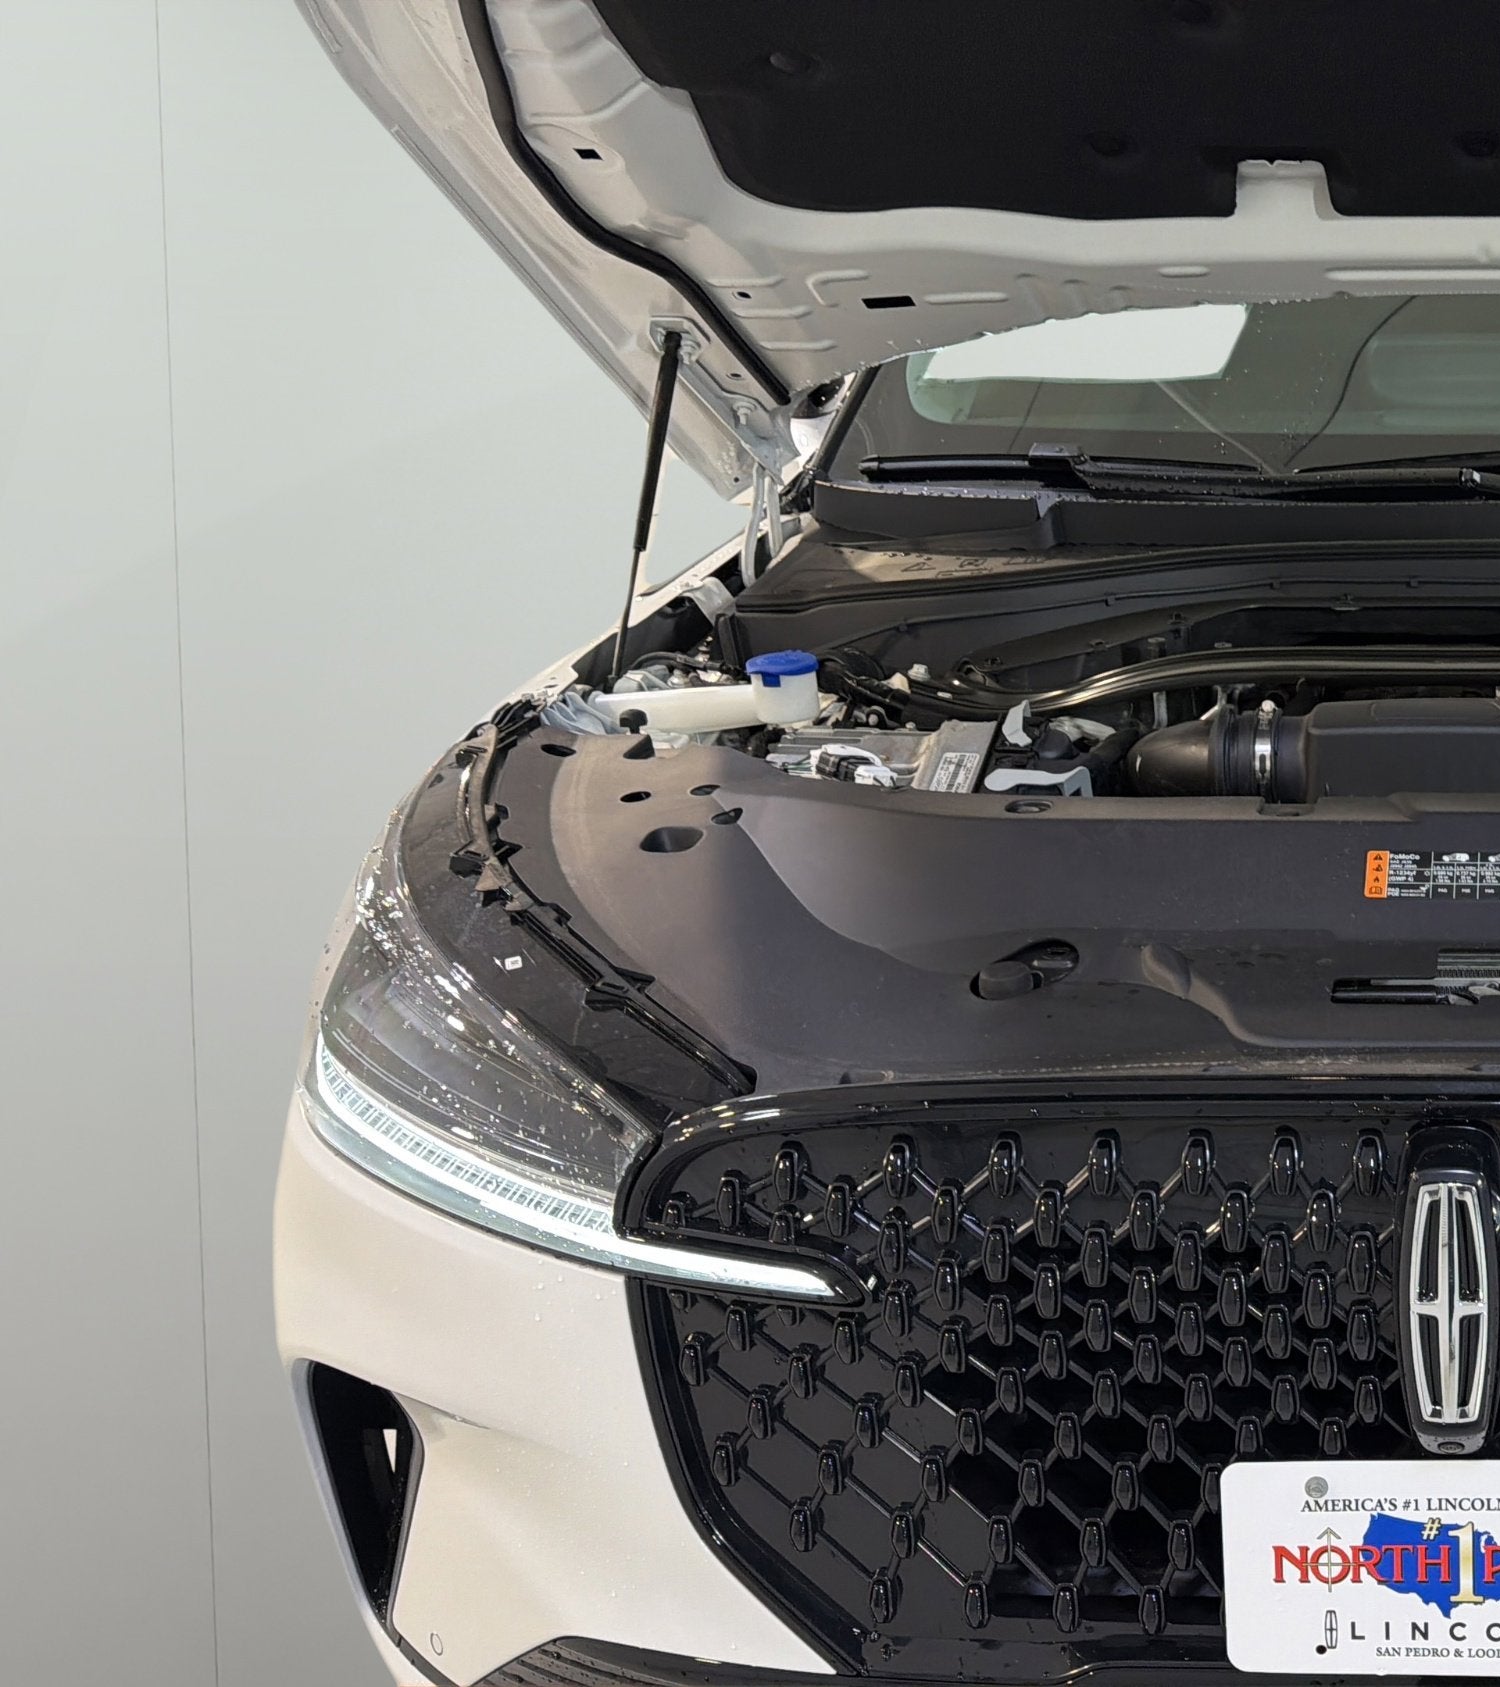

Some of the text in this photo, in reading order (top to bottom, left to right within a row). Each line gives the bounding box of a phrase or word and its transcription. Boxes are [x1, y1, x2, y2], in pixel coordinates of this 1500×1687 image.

[1300, 1497, 1398, 1512] AMERICA'S
[1402, 1498, 1420, 1512] #1
[1272, 1545, 1452, 1584] NORTH
[1376, 1647, 1401, 1657] SAN
[1405, 1647, 1450, 1658] PEDRO
[1453, 1648, 1464, 1658] &
